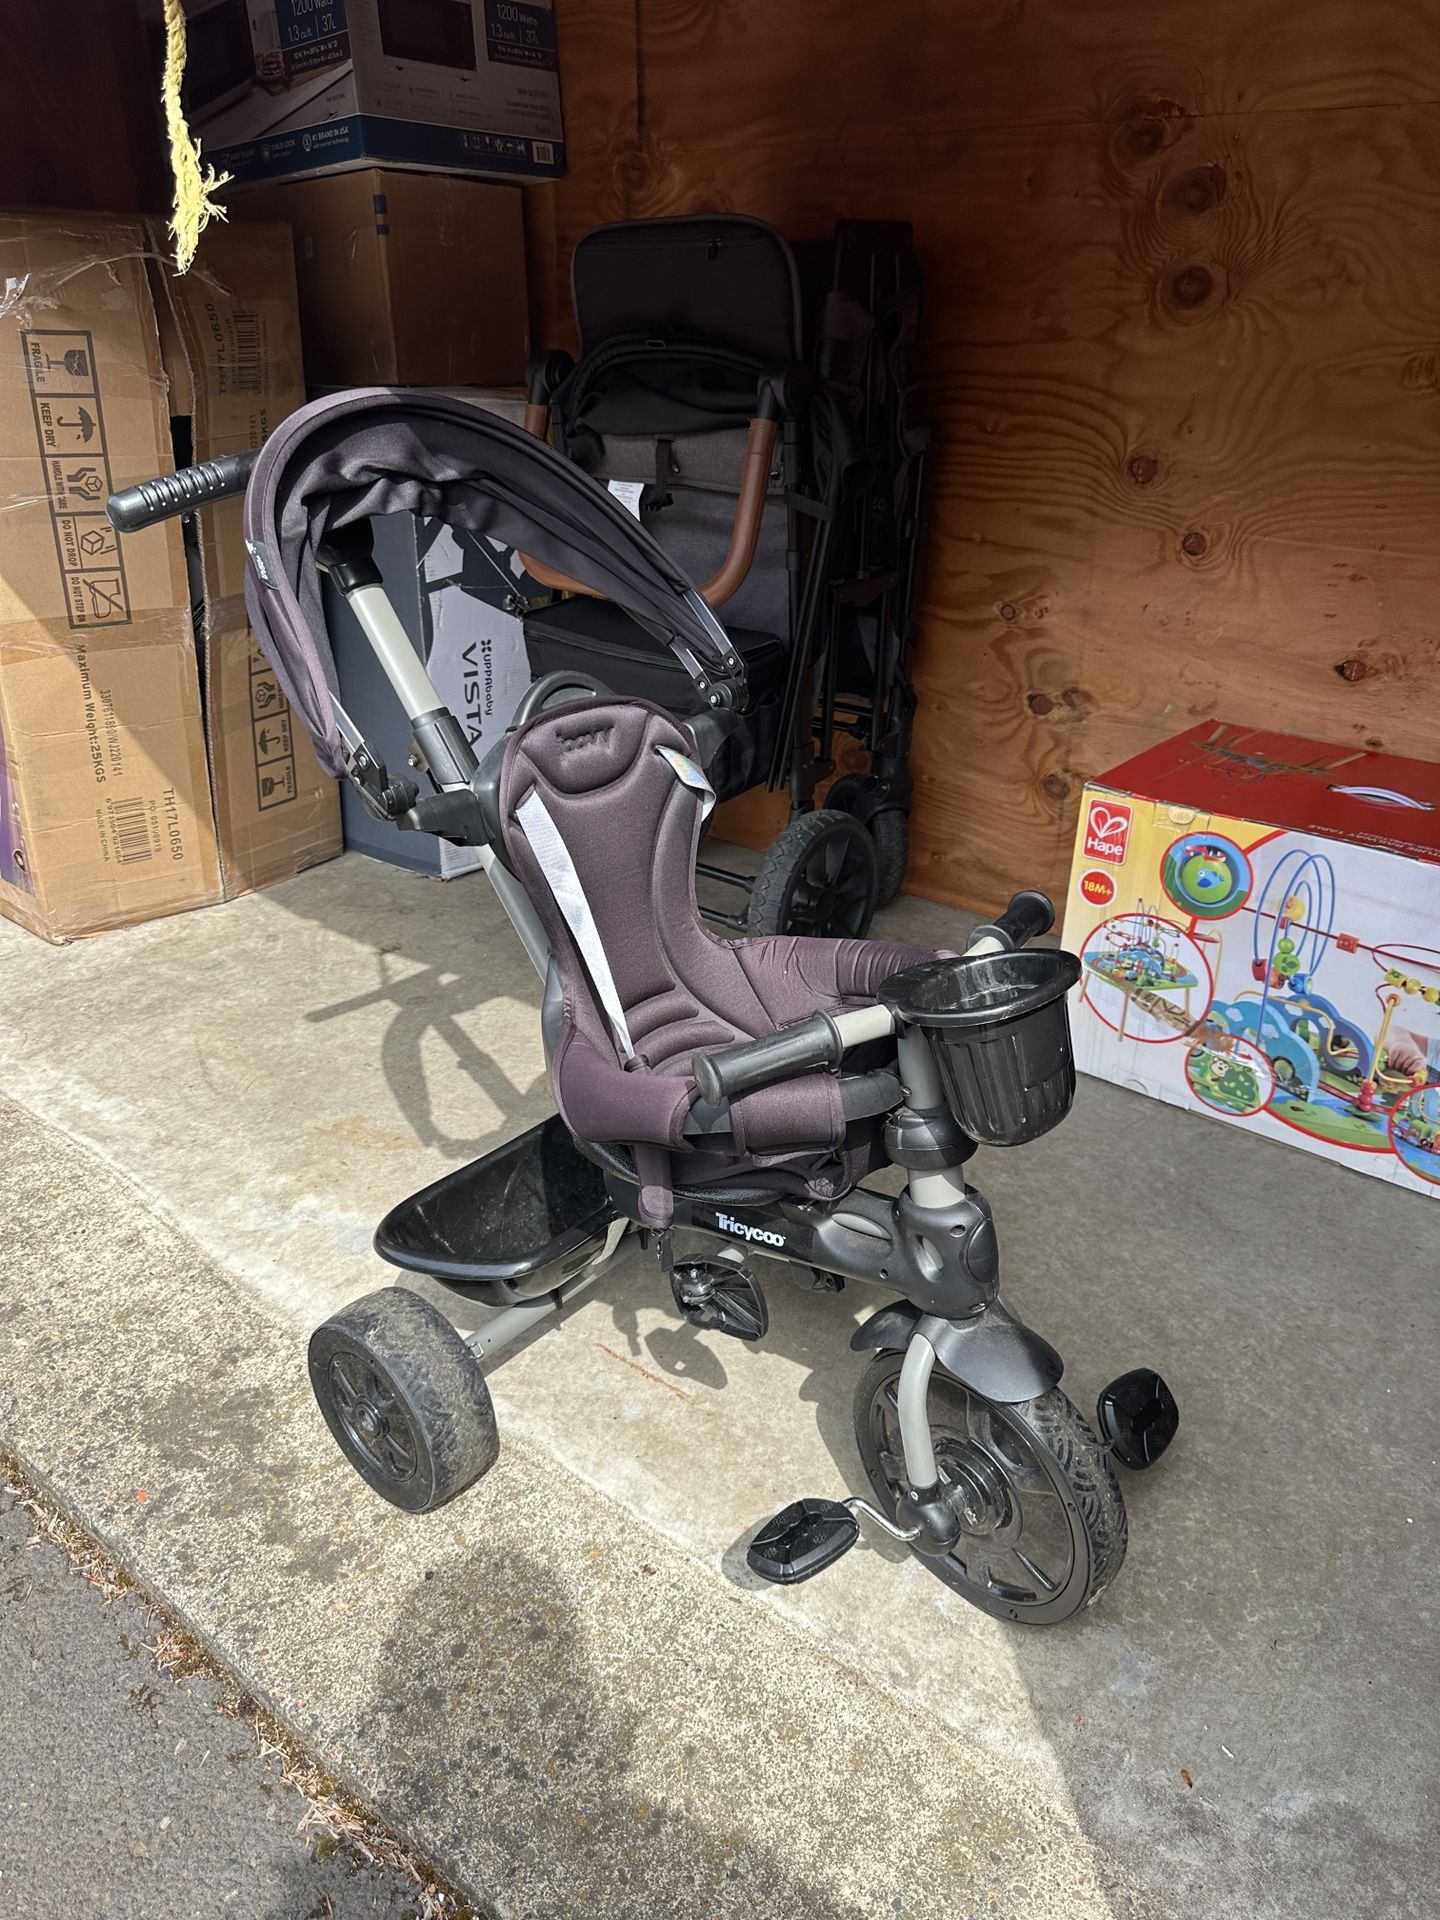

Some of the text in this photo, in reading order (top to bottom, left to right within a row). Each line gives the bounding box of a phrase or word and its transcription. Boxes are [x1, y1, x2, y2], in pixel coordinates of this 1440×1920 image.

[497, 3, 538, 26] 1200 Watts
[30, 342, 46, 383] FRAGILE
[204, 303, 226, 396] TH17L0650
[40, 402, 57, 448] KEEP DRY
[52, 460, 63, 480] HANDLE
[57, 495, 68, 509] CARE
[61, 519, 77, 567] DO NOT DROP
[71, 576, 86, 623] DO NOT STEP ON
[75, 643, 106, 784] Maximum Weight:25KGS
[461, 642, 483, 747] VISTA
[281, 734, 289, 752] KEEP
[95, 808, 110, 862] MADE IN CHINA
[162, 787, 184, 861] TH17L0650
[1087, 837, 1123, 855] Hape
[1083, 880, 1112, 896] 18M+
[715, 1211, 785, 1247] Tricycoo
